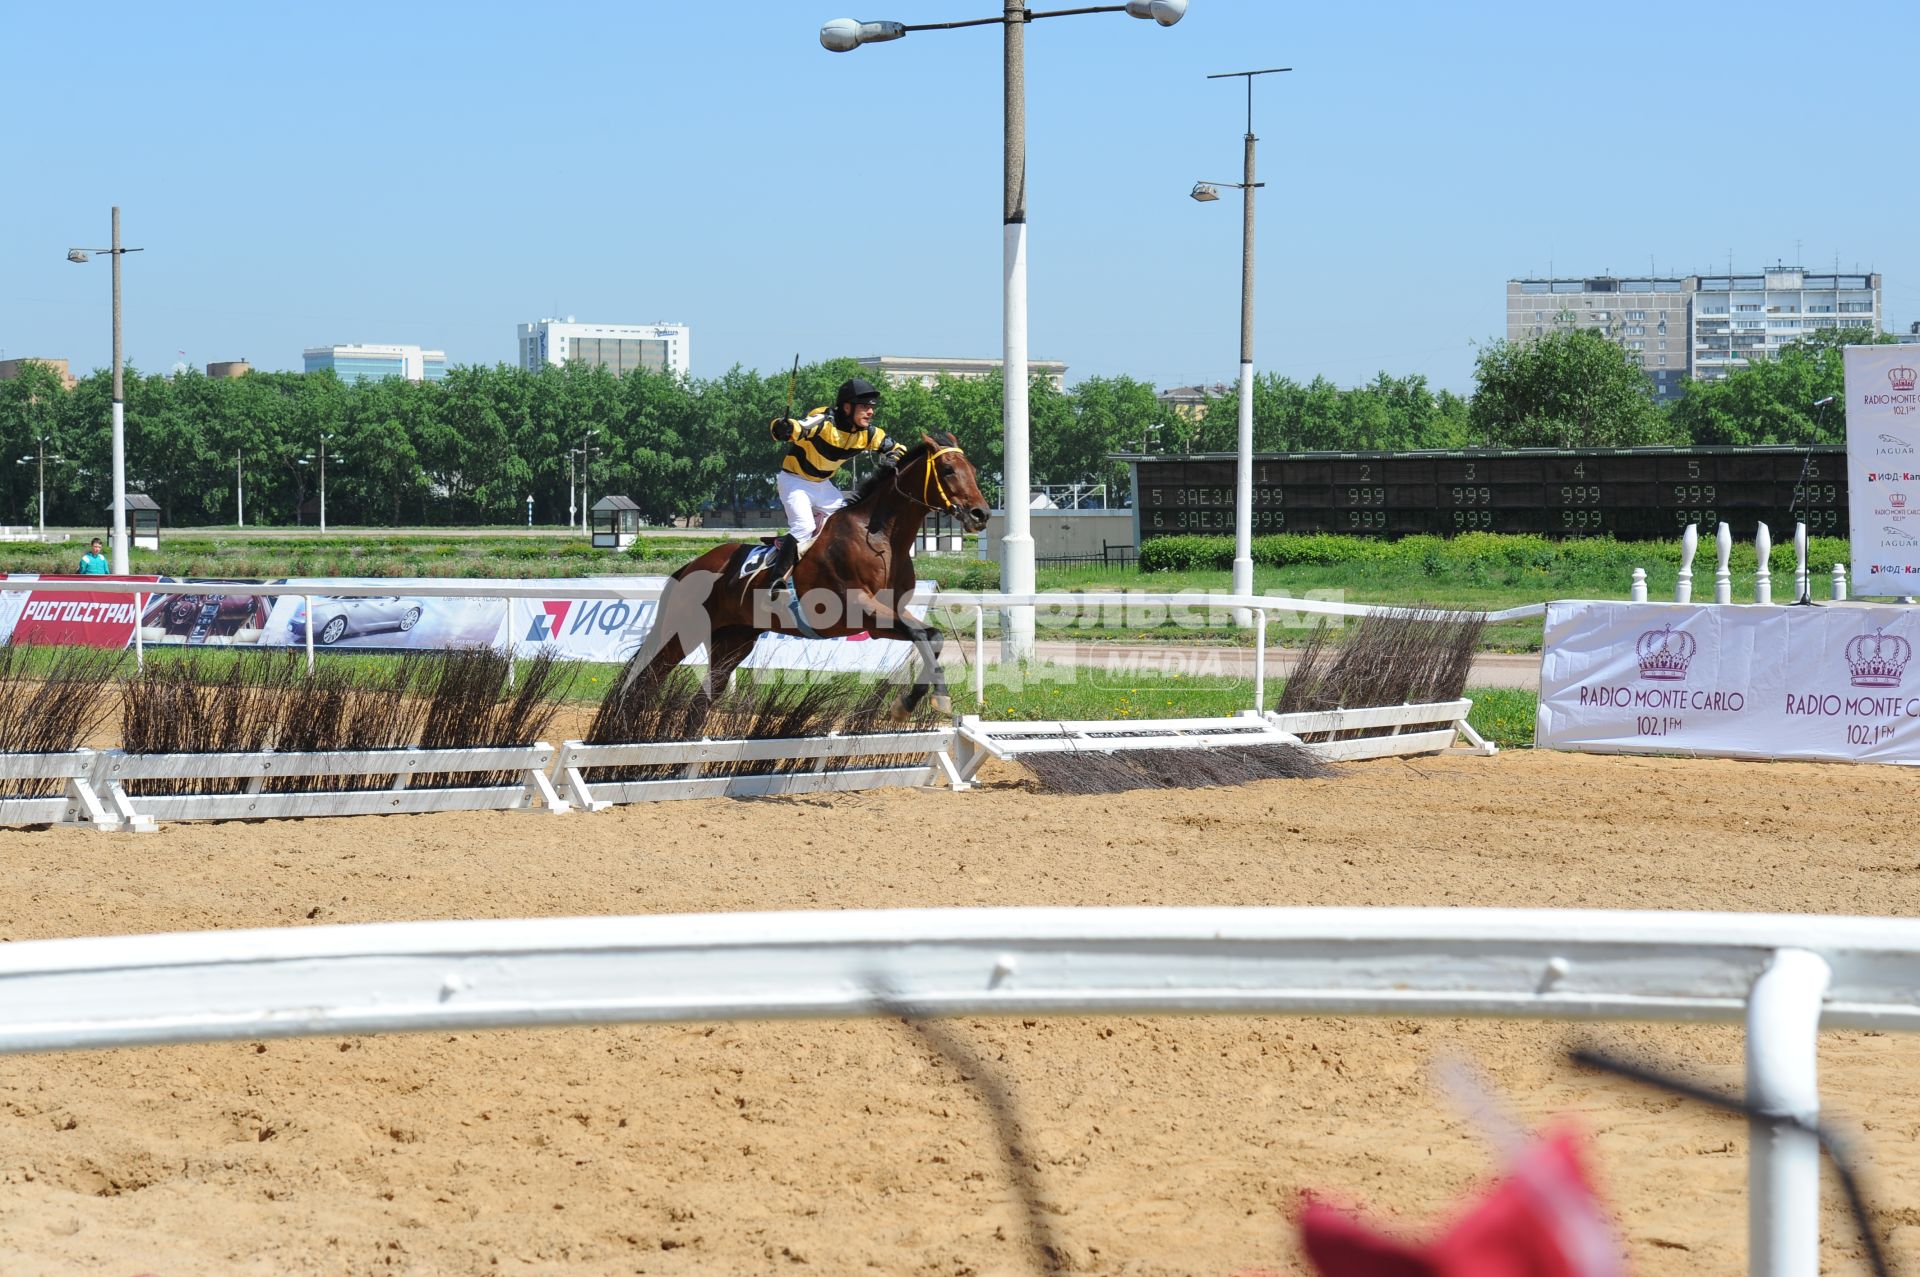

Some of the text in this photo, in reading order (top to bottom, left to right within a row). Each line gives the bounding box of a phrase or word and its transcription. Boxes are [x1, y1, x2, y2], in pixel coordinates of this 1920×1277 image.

[1864, 395, 1890, 405] RADIO
[1891, 395, 1916, 404] MONTE
[1260, 460, 1819, 482] 1 2 3 4 5 6
[1152, 489, 1163, 505] 5
[1176, 489, 1235, 505] ЗАЕЗД
[1348, 488, 1385, 505] 999
[1452, 487, 1490, 504] 999
[1561, 486, 1600, 504] 999
[1674, 486, 1716, 503] 999
[1793, 485, 1836, 503] 999
[1153, 511, 1164, 528] 6
[1177, 511, 1236, 528] ЗАЕЗД
[1350, 511, 1386, 528] 999
[1453, 511, 1492, 528] 999
[1562, 510, 1601, 528] 999
[1676, 510, 1717, 528] 999
[22, 601, 136, 624] РОСГОССТРАХ
[569, 599, 657, 642] ИФД
[1580, 686, 1744, 712] RADIO MONTE CARLO
[1785, 693, 1920, 718] RADIO MONTE C
